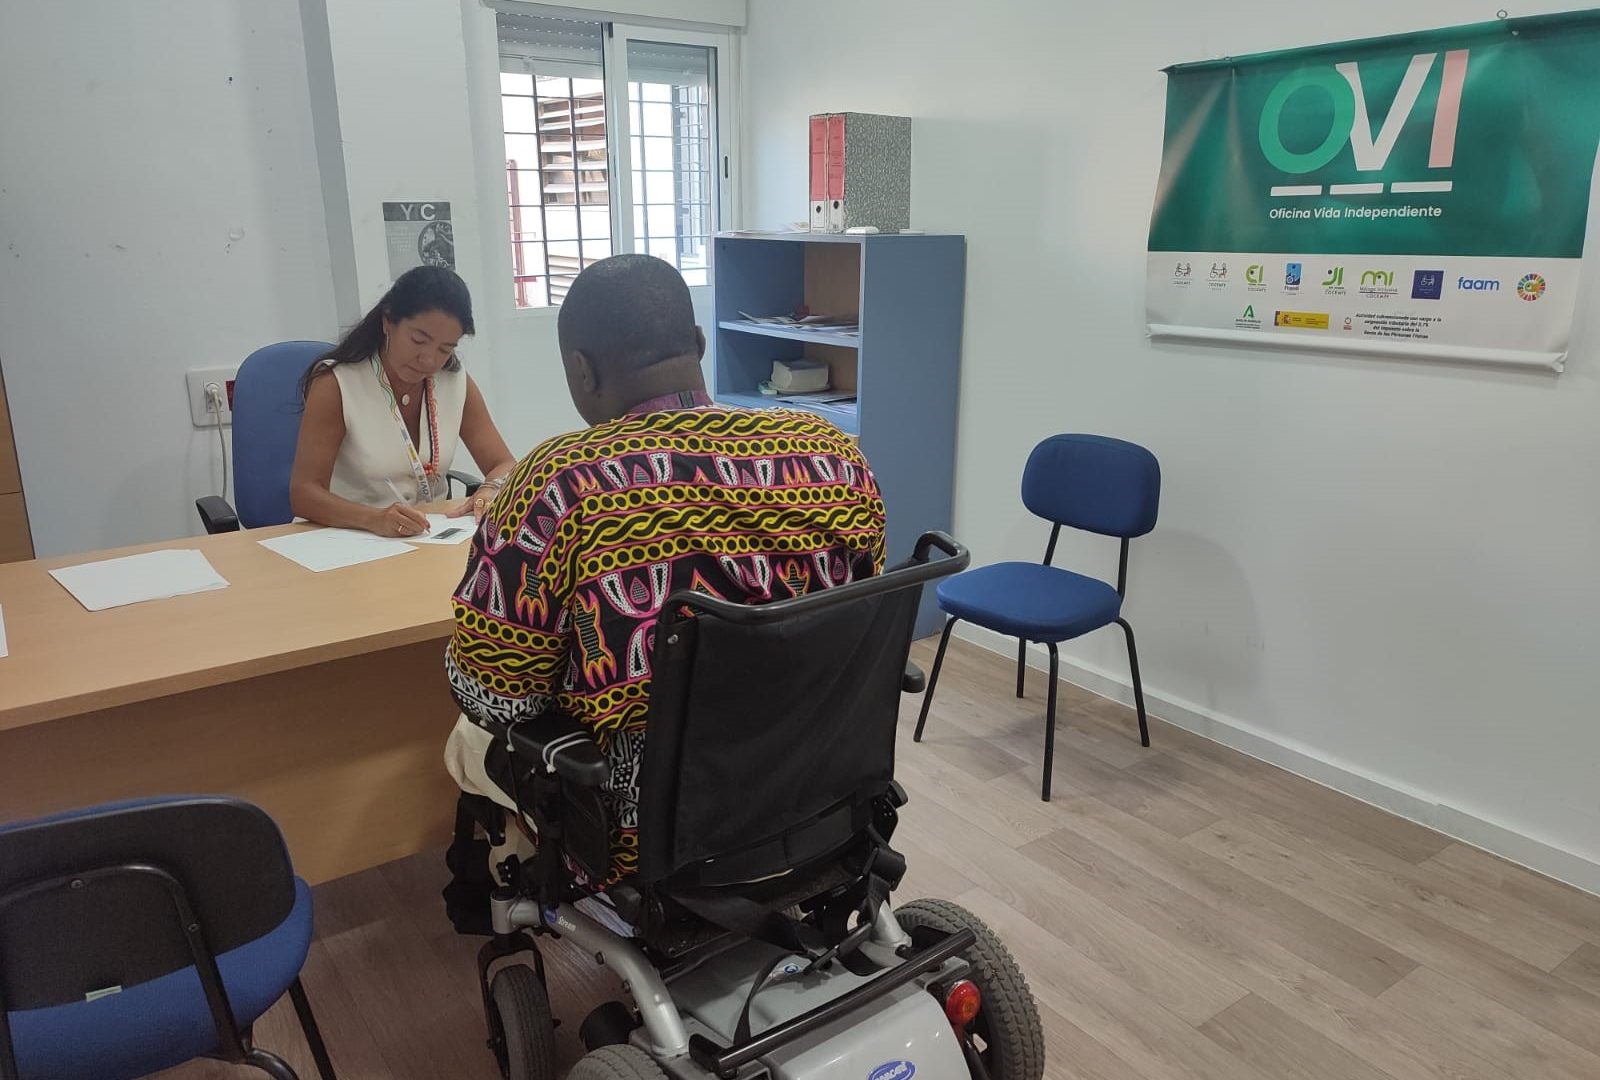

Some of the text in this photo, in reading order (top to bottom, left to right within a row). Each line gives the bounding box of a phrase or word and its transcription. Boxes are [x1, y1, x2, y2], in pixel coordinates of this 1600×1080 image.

[1259, 49, 1470, 173] OVI
[1269, 205, 1442, 220] Oficina Vida Independiente
[1457, 276, 1500, 291] faam
